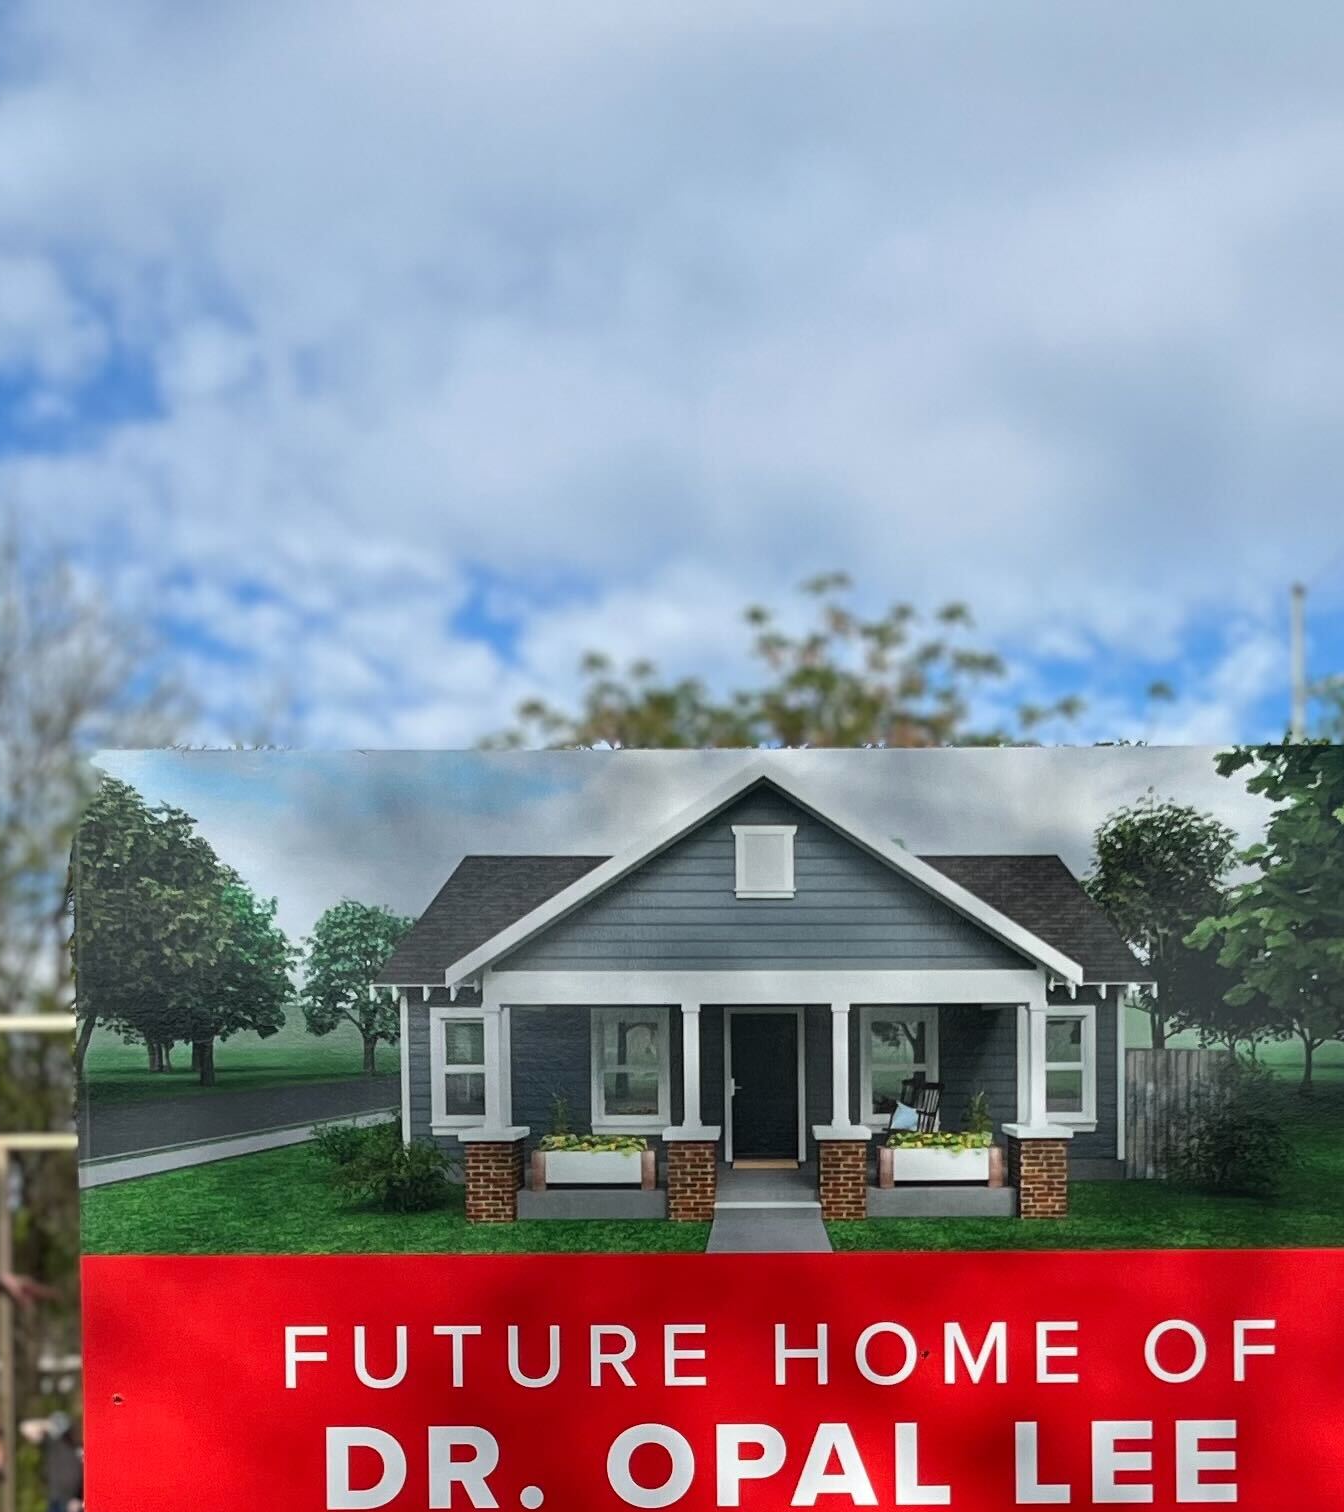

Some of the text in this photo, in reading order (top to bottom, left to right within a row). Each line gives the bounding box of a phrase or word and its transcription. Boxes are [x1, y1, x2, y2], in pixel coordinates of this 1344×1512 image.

[284, 1319, 1277, 1389] FUTURE HOME OF
[325, 1419, 1239, 1511] DR. OPAL LEE
